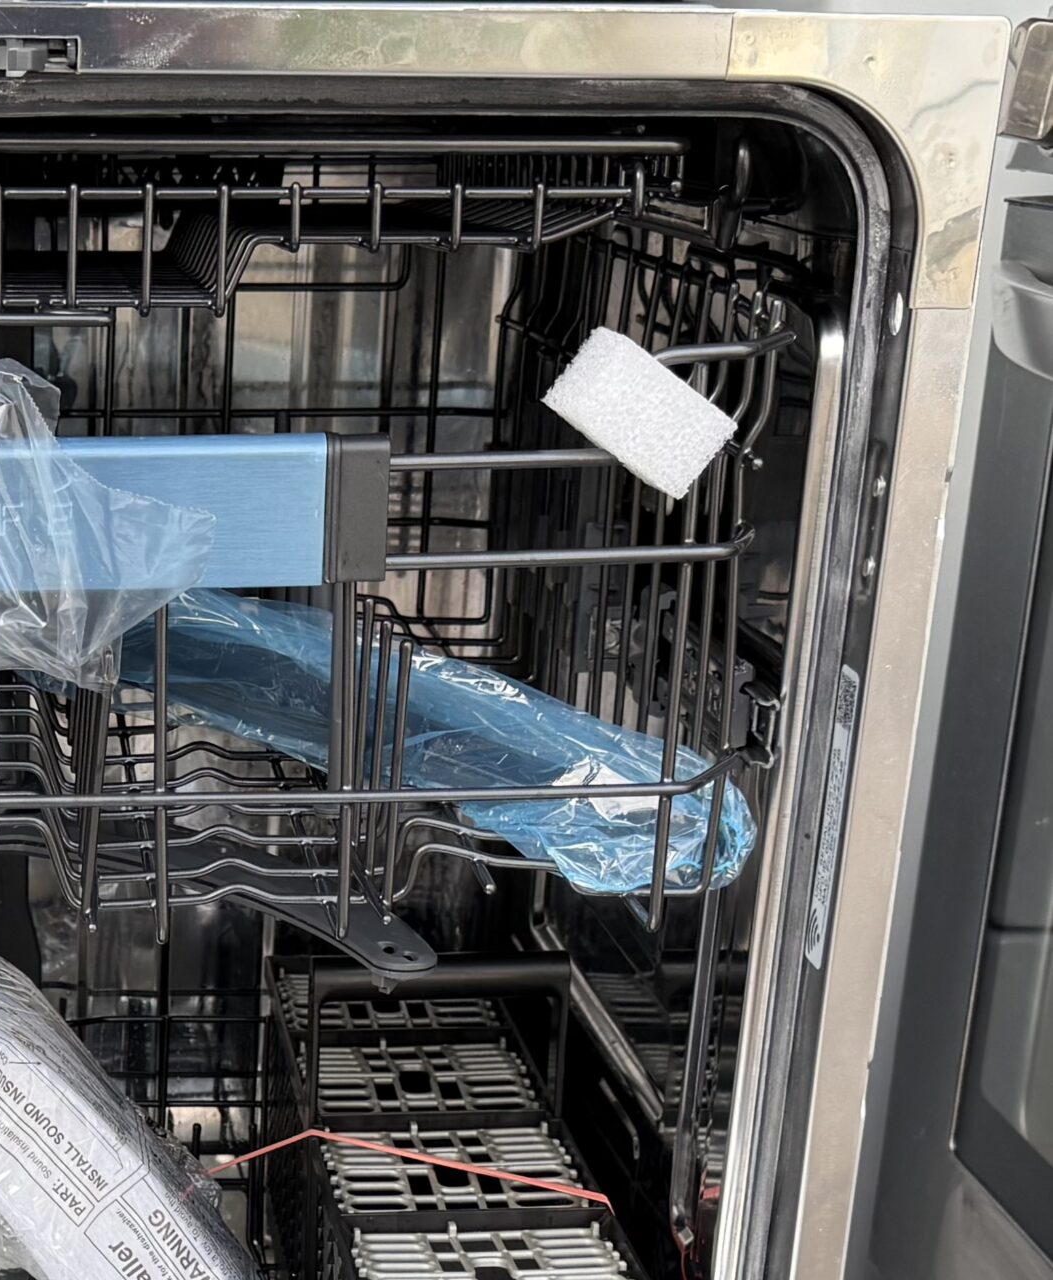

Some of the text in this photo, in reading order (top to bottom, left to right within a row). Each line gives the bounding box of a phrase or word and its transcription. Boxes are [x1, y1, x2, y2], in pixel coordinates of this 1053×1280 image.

[21, 1100, 65, 1145] SOUND
[25, 1150, 53, 1179] Sound
[60, 1140, 108, 1191] INSTALL
[49, 1178, 87, 1216] PART:
[189, 1227, 202, 1241] To
[147, 1249, 159, 1264] the
[156, 1263, 168, 1276] for
